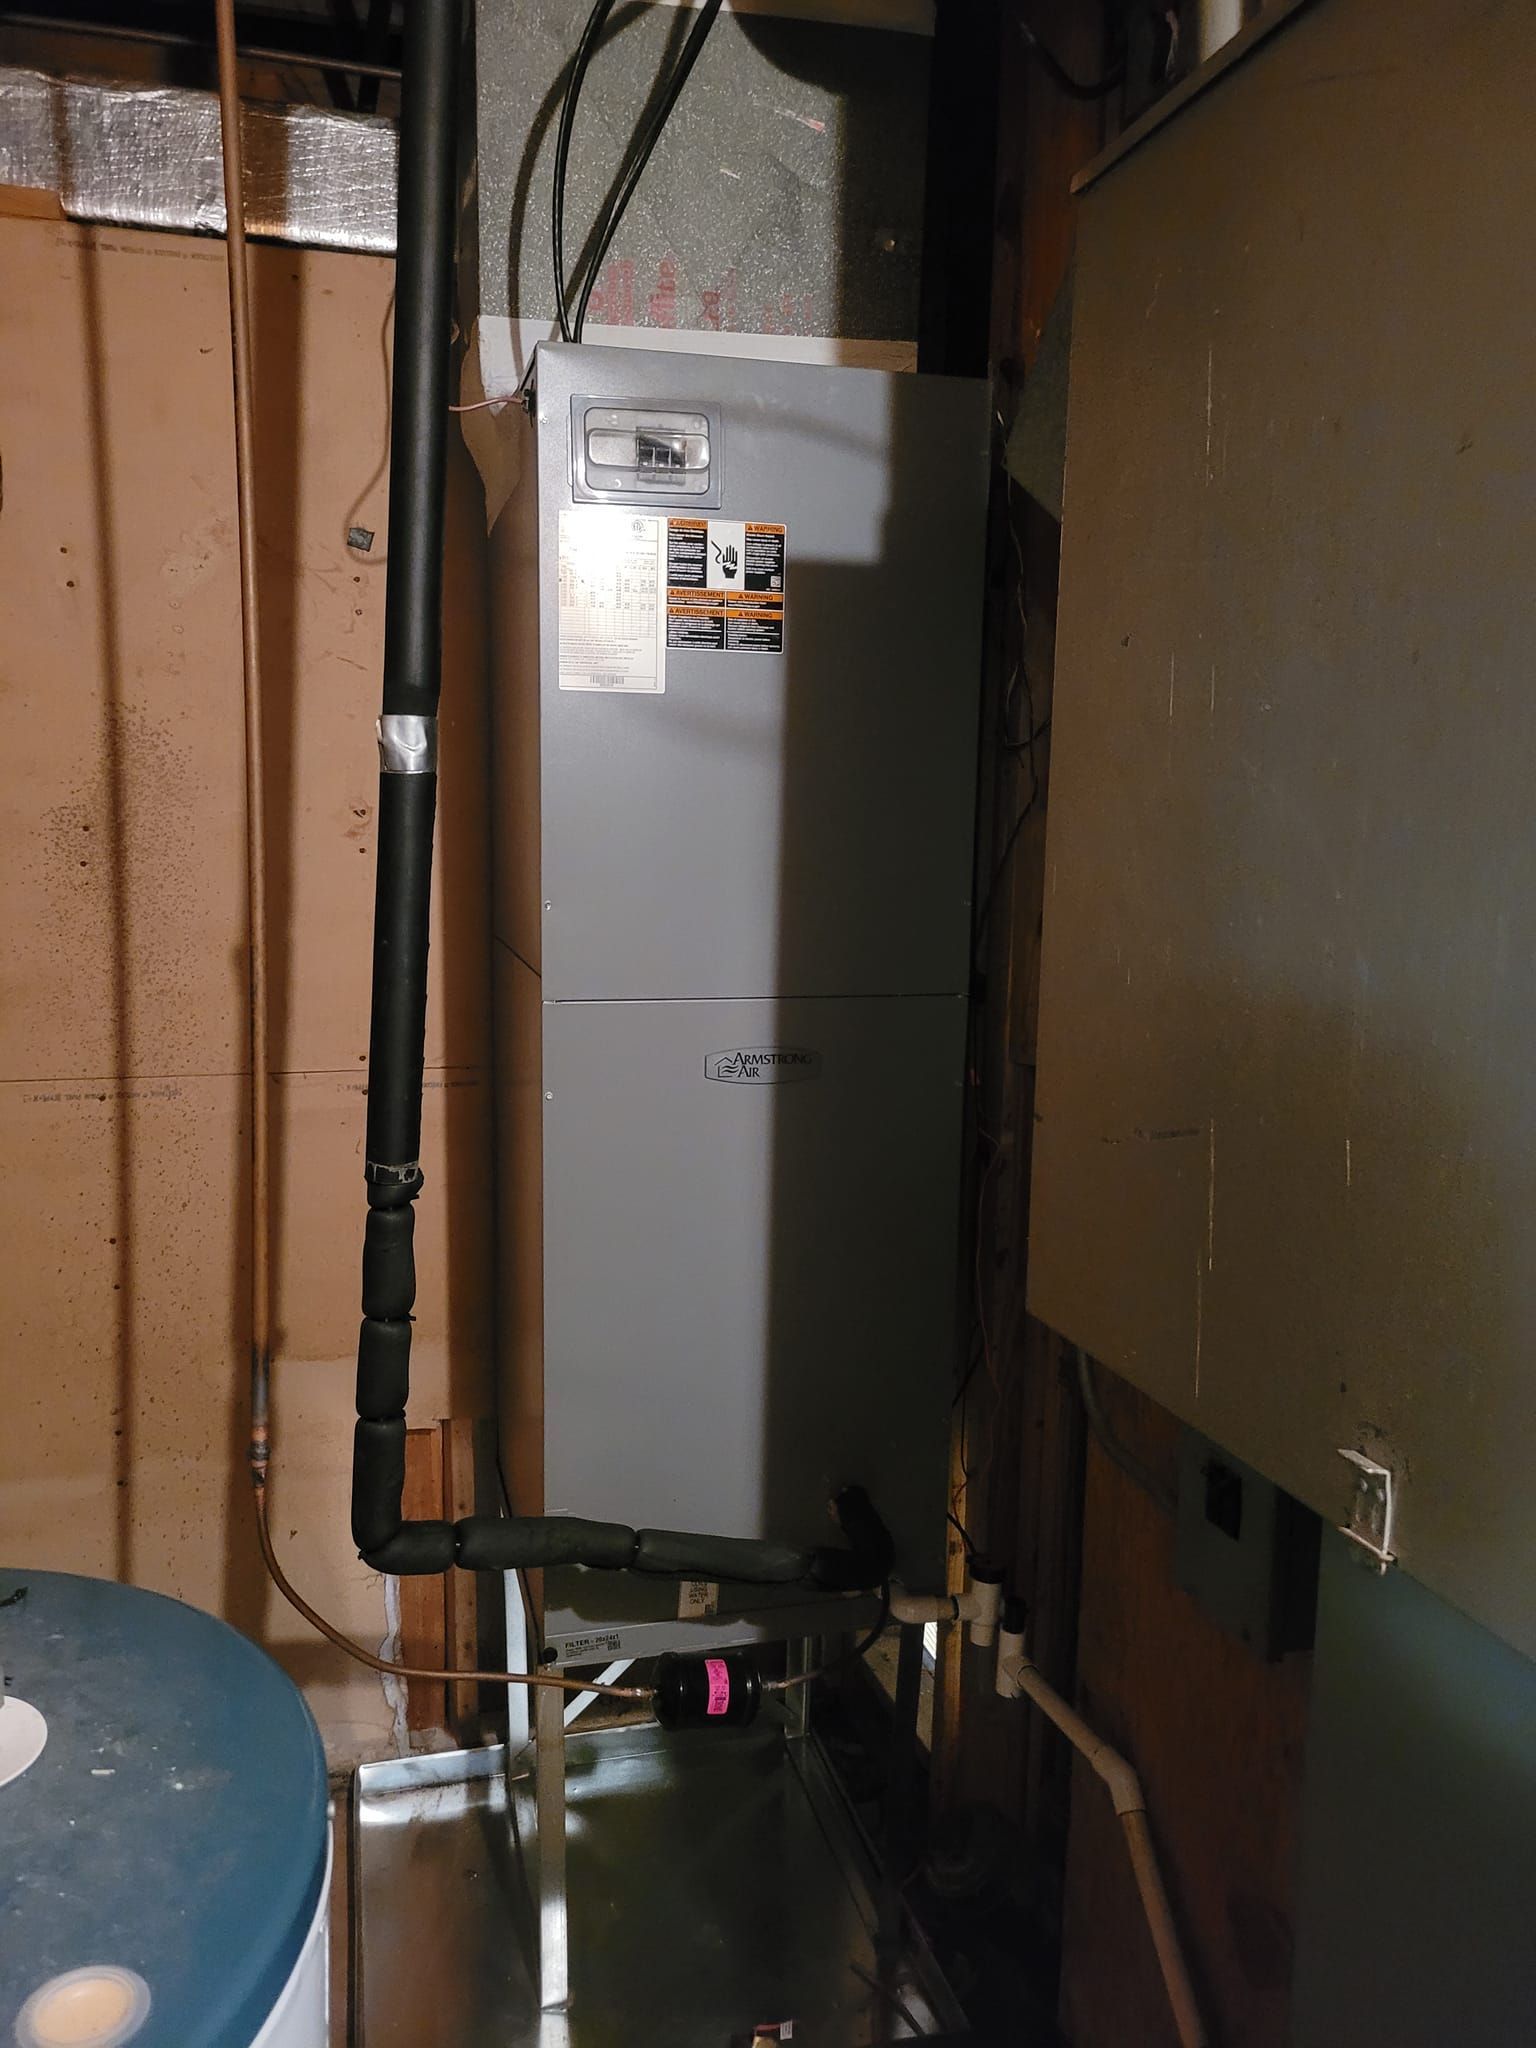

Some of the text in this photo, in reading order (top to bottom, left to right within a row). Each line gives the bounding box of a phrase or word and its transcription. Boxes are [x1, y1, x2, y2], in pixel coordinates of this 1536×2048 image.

[733, 1052, 812, 1065] ARMSTRONG
[737, 1065, 760, 1077] AIR
[565, 1639, 590, 1649] FILTER
